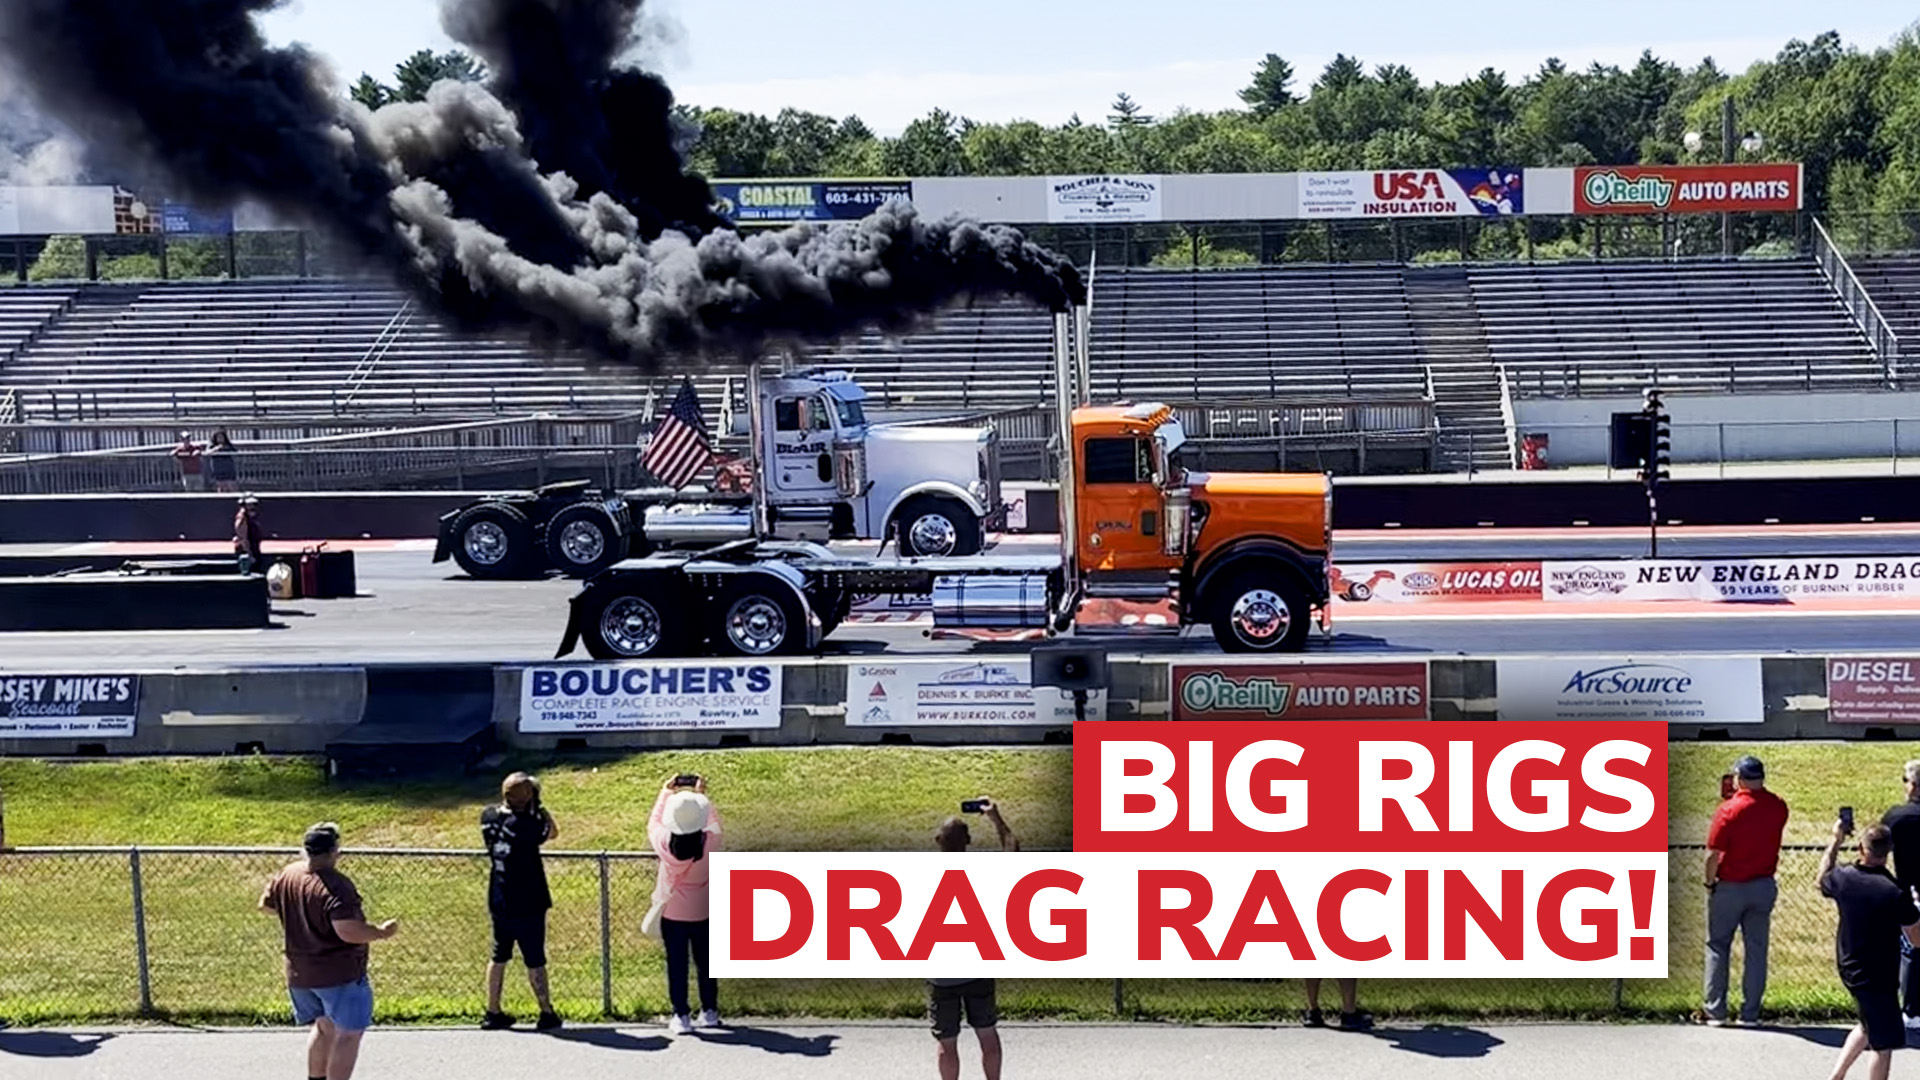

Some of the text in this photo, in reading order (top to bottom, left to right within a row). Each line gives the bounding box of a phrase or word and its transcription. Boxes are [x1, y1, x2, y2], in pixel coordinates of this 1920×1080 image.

[739, 185, 816, 207] COASTAL
[1374, 172, 1445, 201] USA
[1586, 174, 1673, 209] O'Reilly
[1678, 180, 1790, 201] AUTO PARTS
[1363, 201, 1457, 214] INSULATION
[776, 442, 827, 454] BLAIR
[1441, 569, 1541, 588] LUCAS OIL
[1551, 571, 1626, 580] NEW ENGLAND
[1636, 567, 1702, 583] NEW
[1711, 564, 1839, 583] ENGLAND
[1564, 581, 1613, 589] DRAGWAY
[1739, 585, 1779, 595] YEARS
[1782, 584, 1798, 594] OF
[1857, 582, 1905, 592] RUBBER
[532, 665, 772, 697] BOUCHER'S
[1831, 662, 1916, 682] DIESEL
[0, 678, 130, 702] SEY MIKE'S
[1562, 670, 1692, 694] ArcSource
[531, 694, 771, 711] COMPLETE RACE ENGINE SERVICE
[917, 690, 957, 700] DENNIS
[974, 690, 1010, 699] BURKE
[1184, 673, 1289, 714] O'Reilly
[1295, 687, 1421, 706] AUTO PARTS
[699, 708, 759, 719] Rowley, MA
[917, 711, 1036, 720] WWW.BURKEOIL.COM
